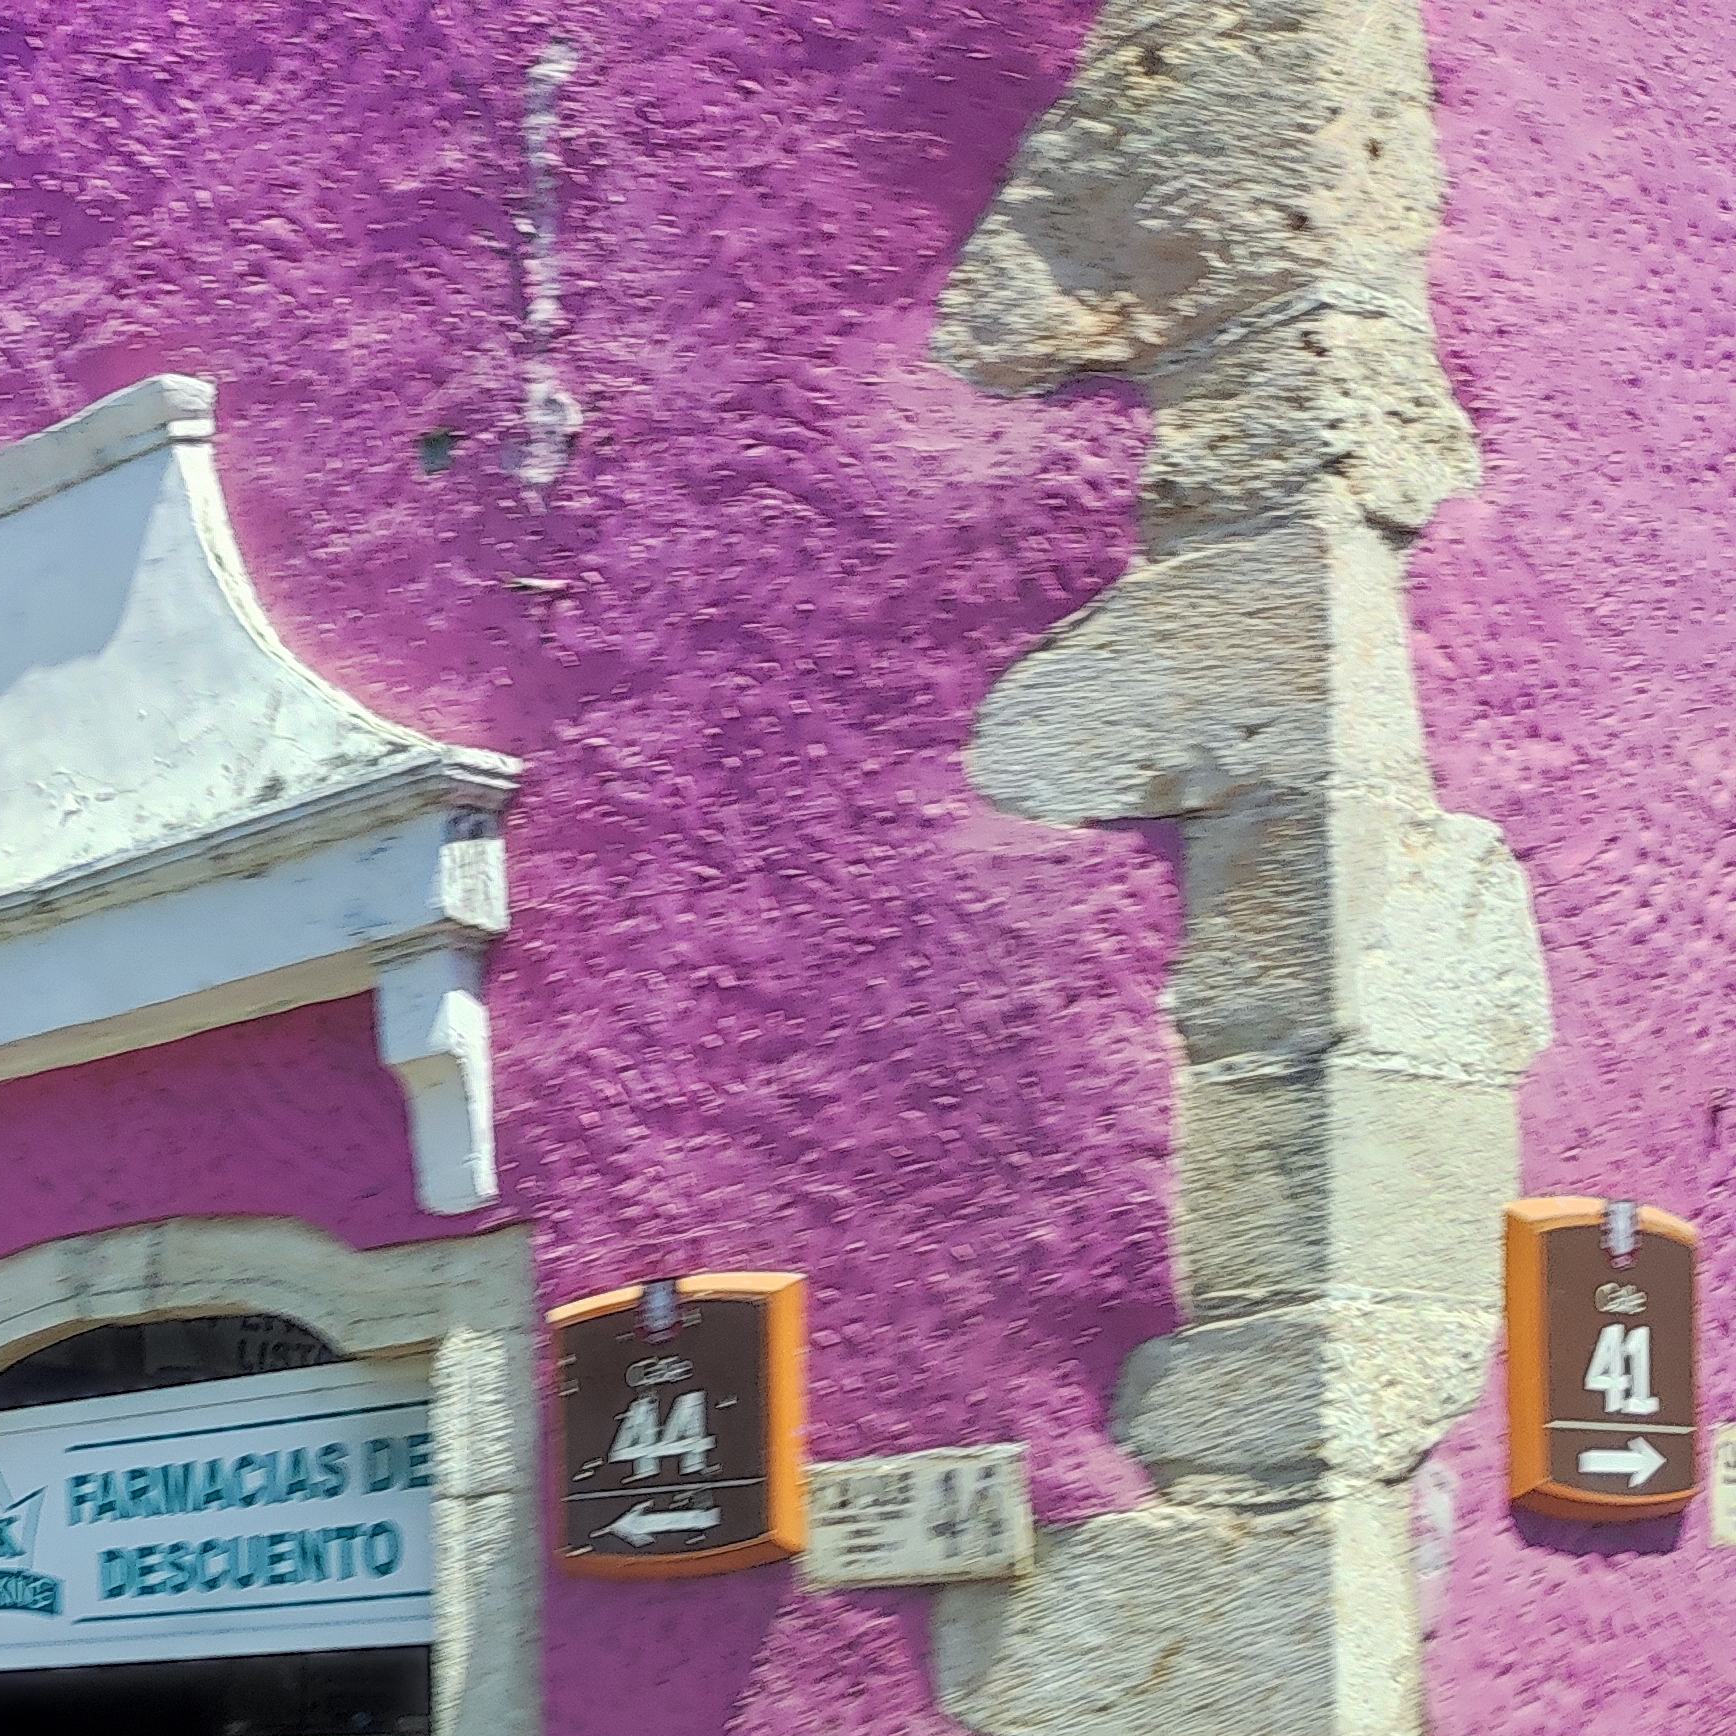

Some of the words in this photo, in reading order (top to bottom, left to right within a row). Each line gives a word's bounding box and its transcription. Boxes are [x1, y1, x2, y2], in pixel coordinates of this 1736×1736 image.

[1584, 1322, 1659, 1414] 41
[65, 1442, 349, 1526] FARMACIAS
[362, 1432, 433, 1494] DE
[608, 1389, 717, 1484] 44
[97, 1520, 402, 1602] DESCUENTO
